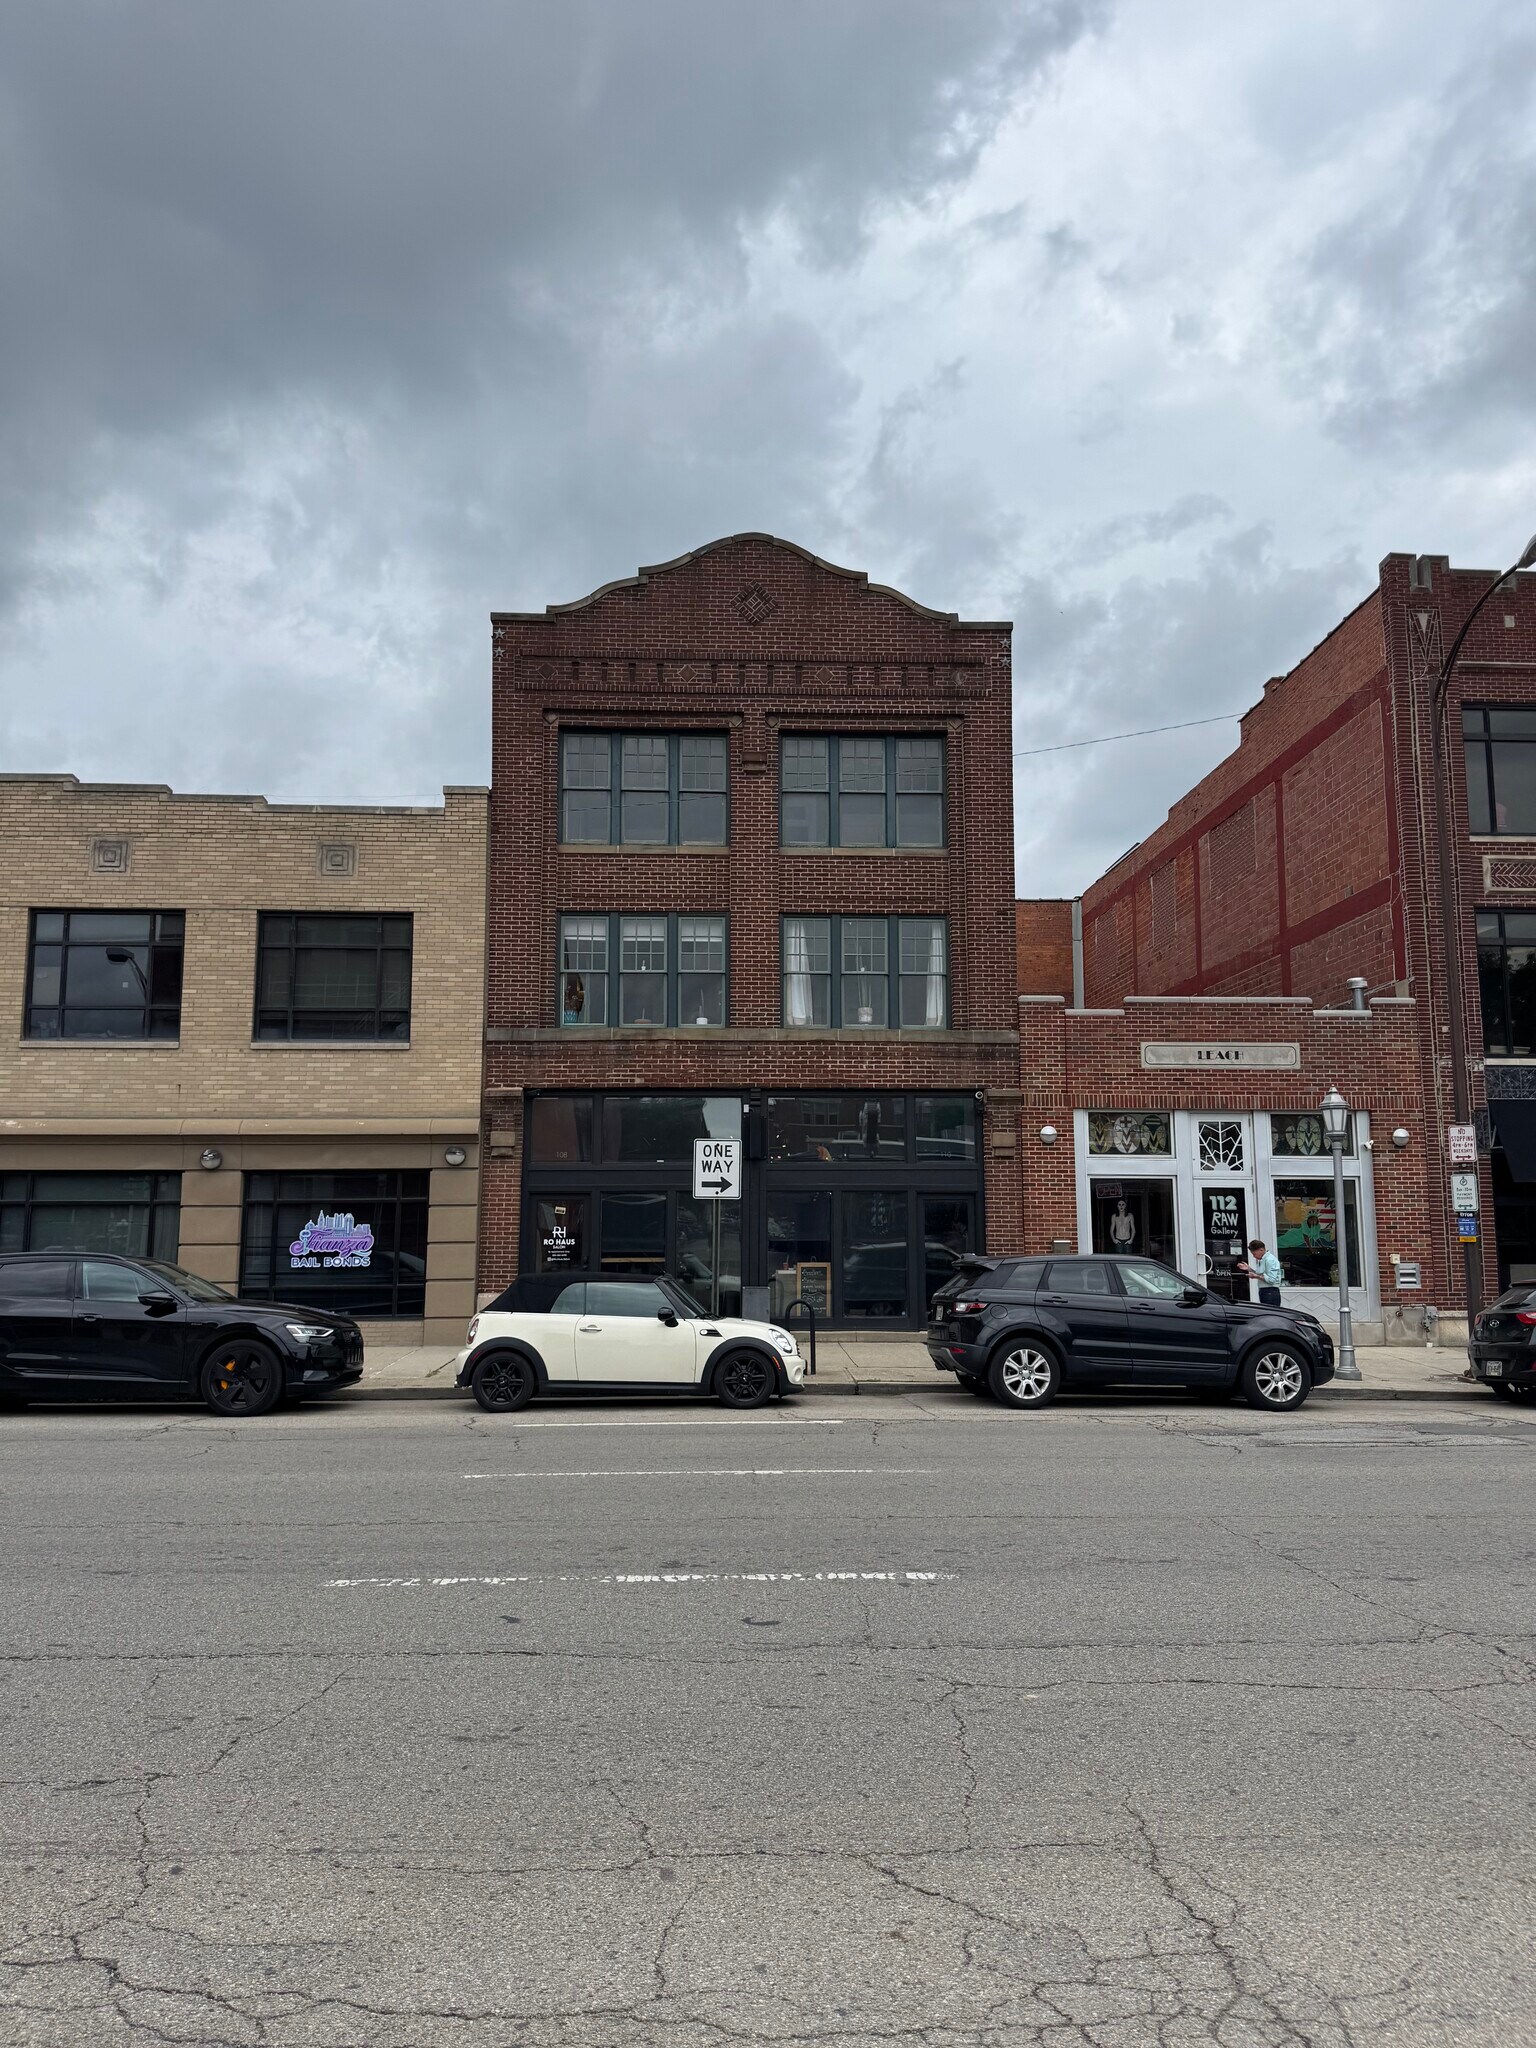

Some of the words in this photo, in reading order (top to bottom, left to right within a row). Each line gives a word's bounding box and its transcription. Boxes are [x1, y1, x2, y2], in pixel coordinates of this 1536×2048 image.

[1197, 1051, 1244, 1060] LEACH
[703, 1144, 733, 1158] ONE
[701, 1160, 734, 1173] WAY
[1209, 1195, 1238, 1211] 112
[1211, 1212, 1239, 1226] RAW
[1210, 1226, 1239, 1239] Gallery
[543, 1238, 554, 1246] RO
[555, 1238, 576, 1246] HAUS
[291, 1257, 321, 1268] BAIL
[323, 1257, 371, 1268] BONDS
